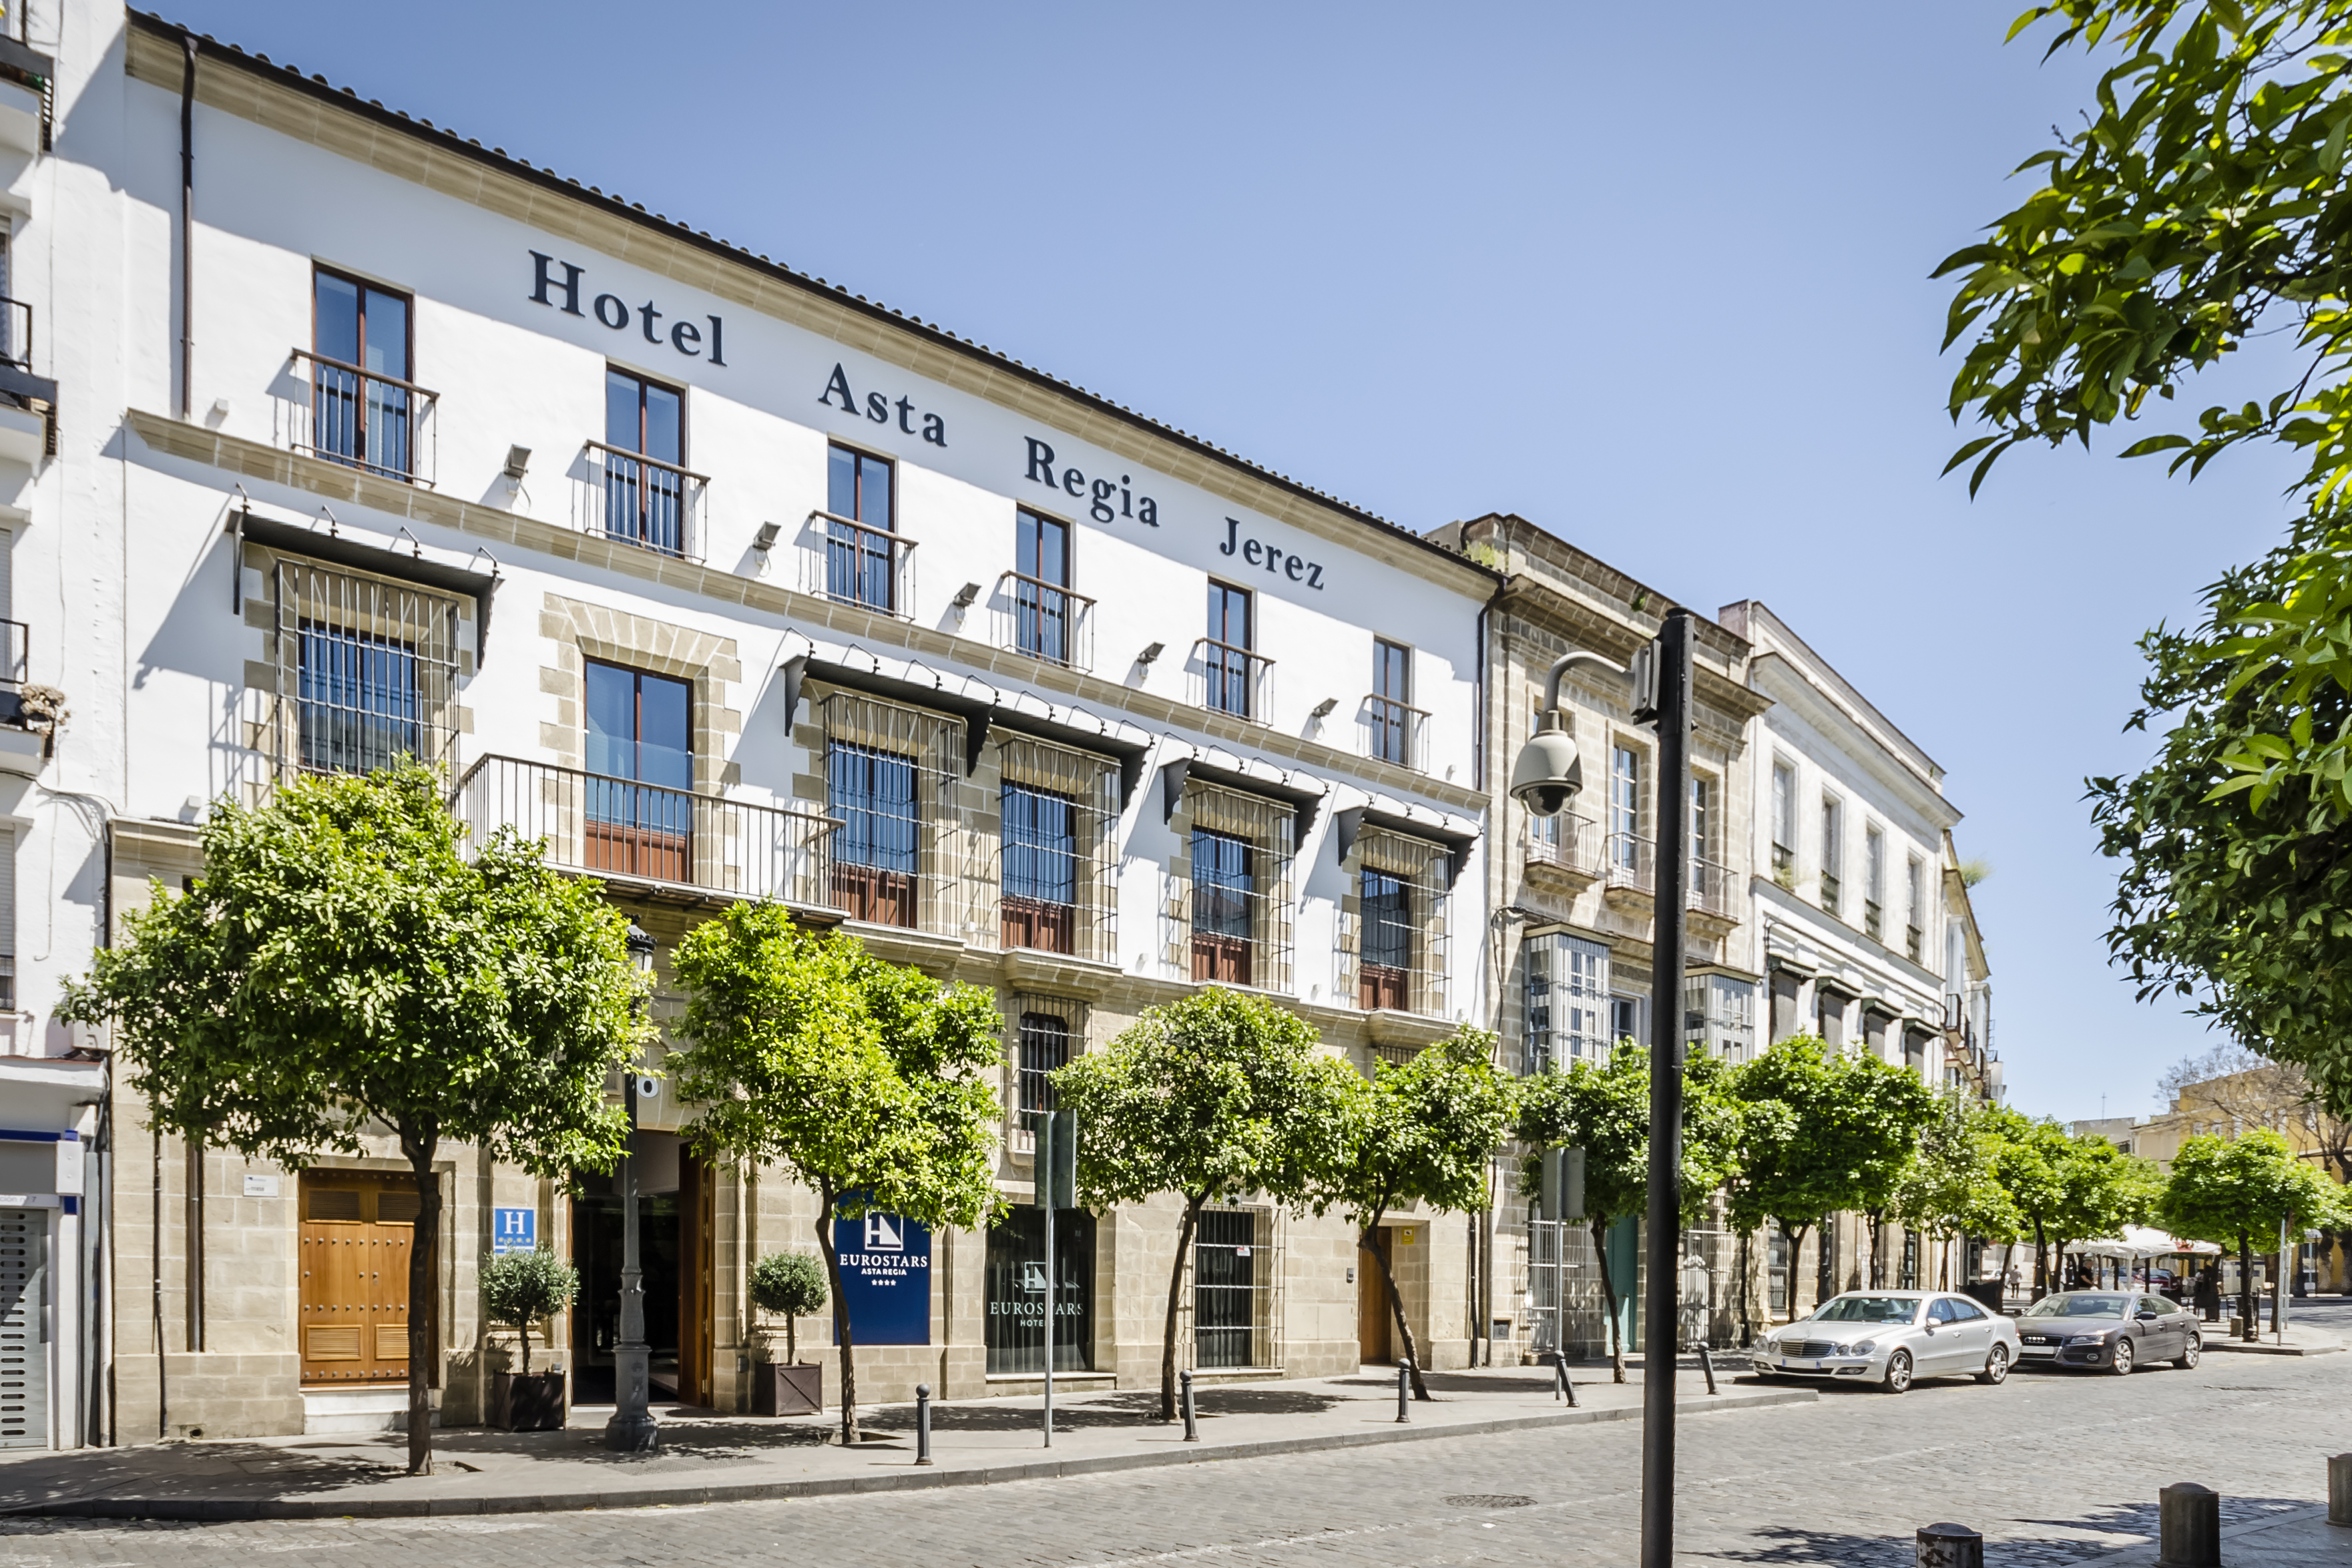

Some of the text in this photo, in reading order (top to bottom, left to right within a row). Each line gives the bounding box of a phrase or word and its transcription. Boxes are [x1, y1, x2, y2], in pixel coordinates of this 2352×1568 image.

[528, 249, 1325, 591] Hotel Asta Regia Jerez
[504, 1211, 525, 1235] H
[839, 1254, 928, 1268] EUROSTARS
[861, 1268, 882, 1276] ASTA
[990, 1302, 1084, 1315] EUROSARS
[1020, 1319, 1054, 1327] HOTE
